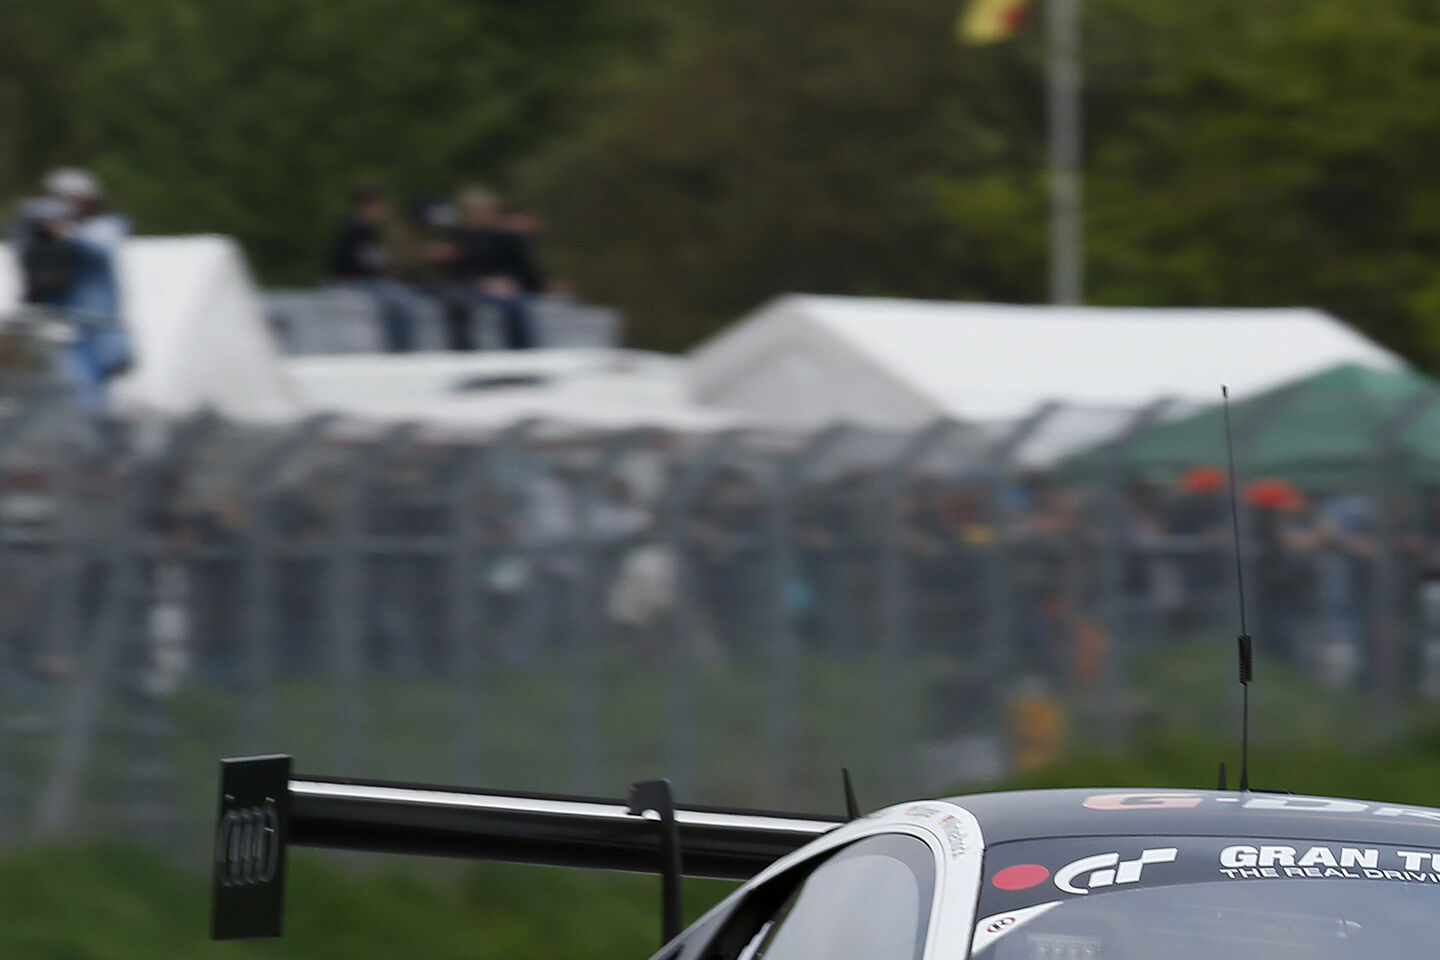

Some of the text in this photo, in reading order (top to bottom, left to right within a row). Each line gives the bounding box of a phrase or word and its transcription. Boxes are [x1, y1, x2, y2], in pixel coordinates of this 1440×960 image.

[1219, 845, 1379, 869] GRAN
[1219, 867, 1280, 880] THE
[1284, 866, 1360, 880] REAL
